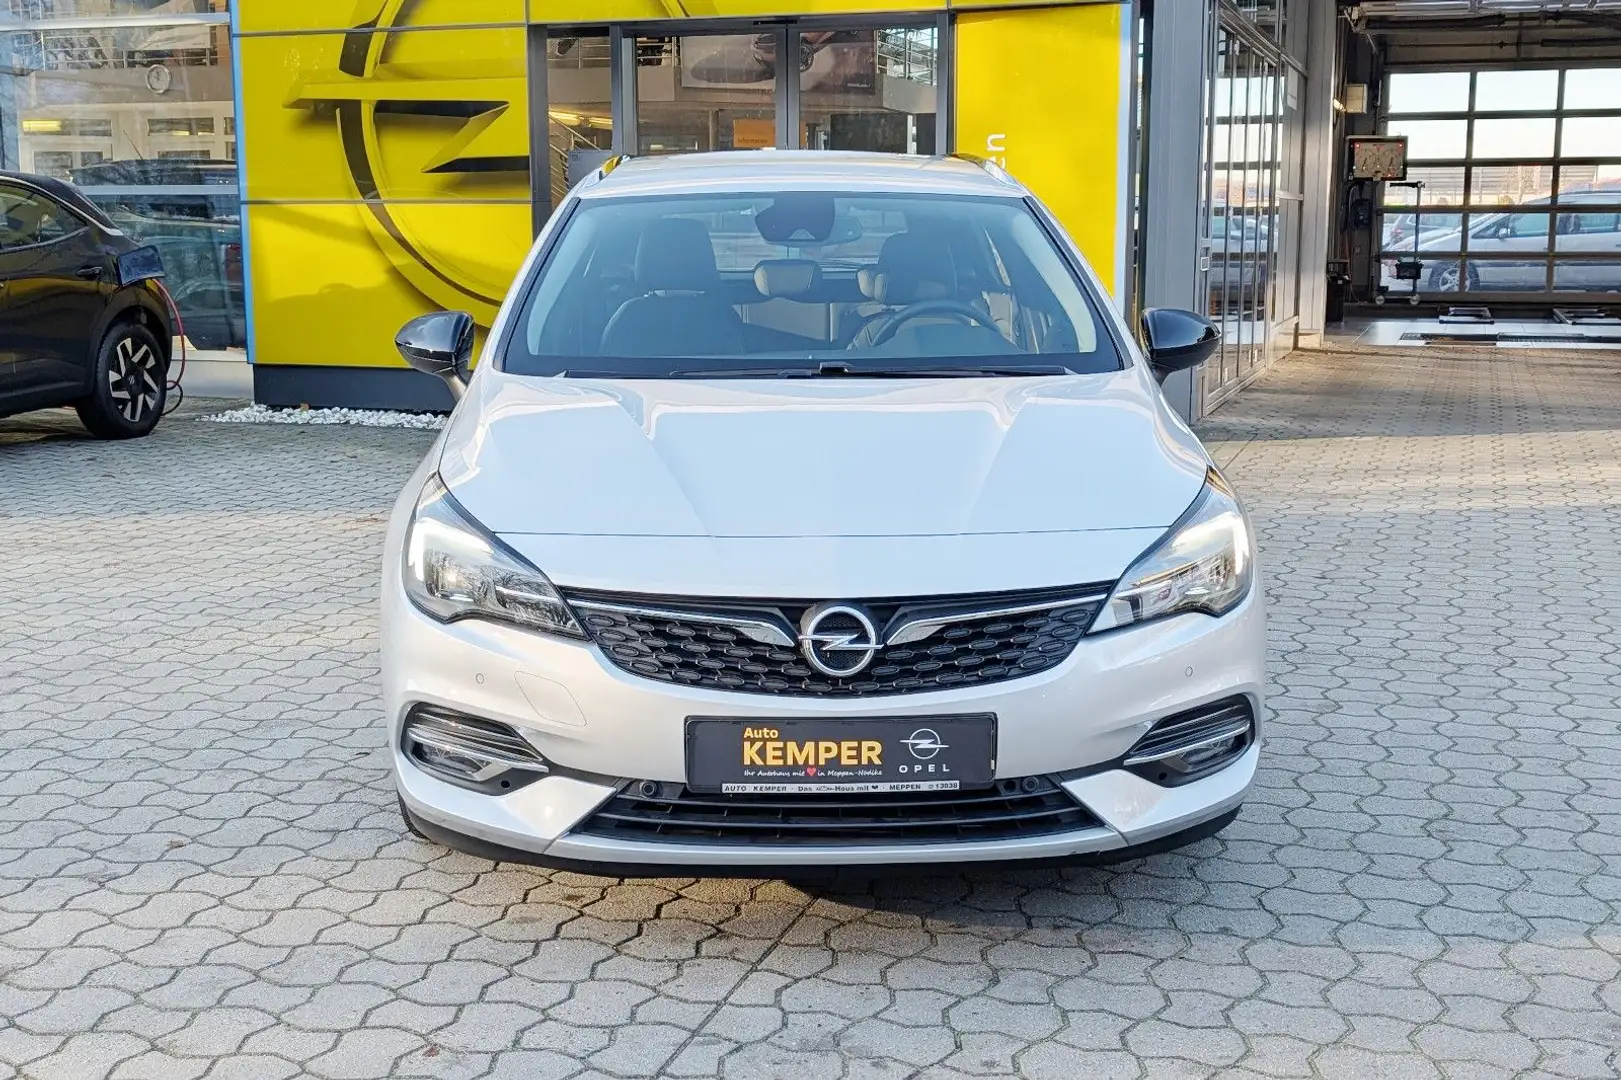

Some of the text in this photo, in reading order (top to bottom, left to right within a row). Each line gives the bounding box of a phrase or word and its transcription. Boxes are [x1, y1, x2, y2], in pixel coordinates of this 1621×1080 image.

[743, 727, 779, 739] Auto
[743, 740, 882, 766] KEMPER
[744, 768, 756, 777] Ihr
[792, 768, 805, 777] mit
[817, 769, 826, 777] in
[898, 764, 950, 774] OPEL
[724, 784, 747, 792] AUTO
[752, 784, 788, 792] KEMPER
[797, 784, 813, 792] Das
[856, 784, 870, 792] mit
[889, 783, 921, 791] MEPPEN
